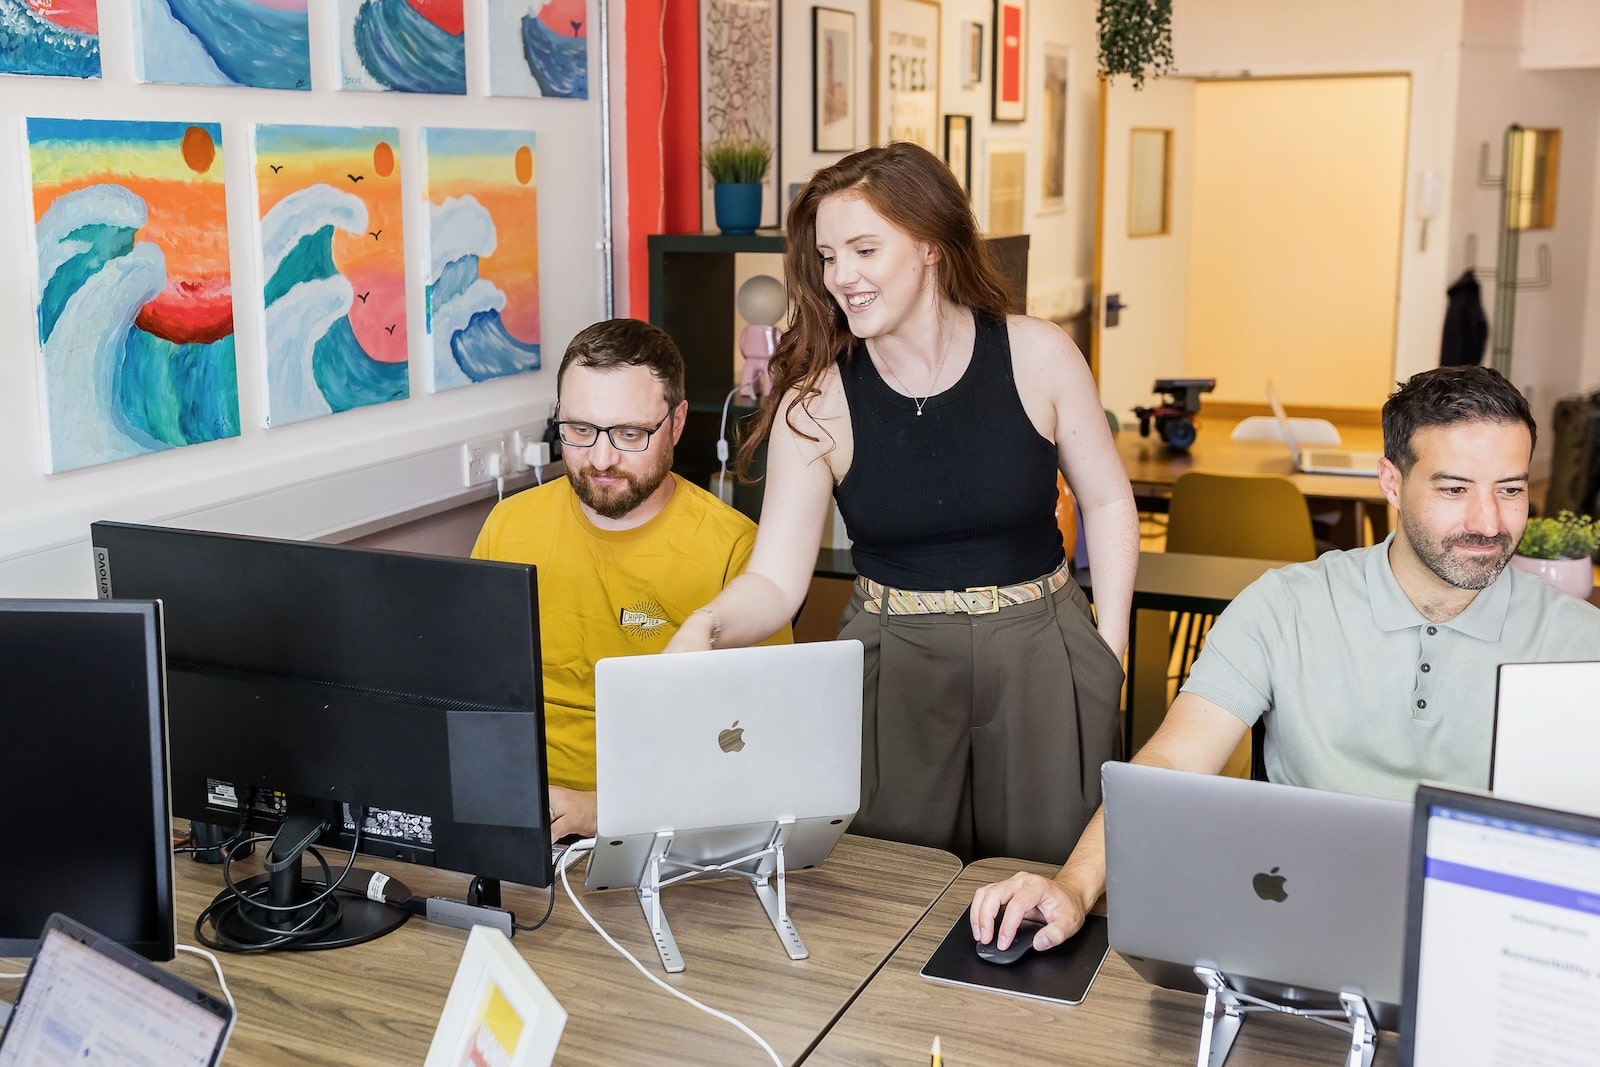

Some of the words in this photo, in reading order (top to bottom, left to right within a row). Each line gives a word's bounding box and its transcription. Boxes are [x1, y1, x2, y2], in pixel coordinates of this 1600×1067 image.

[889, 54, 926, 91] EYES
[623, 611, 647, 624] CHIPPY
[648, 618, 660, 626] TEA
